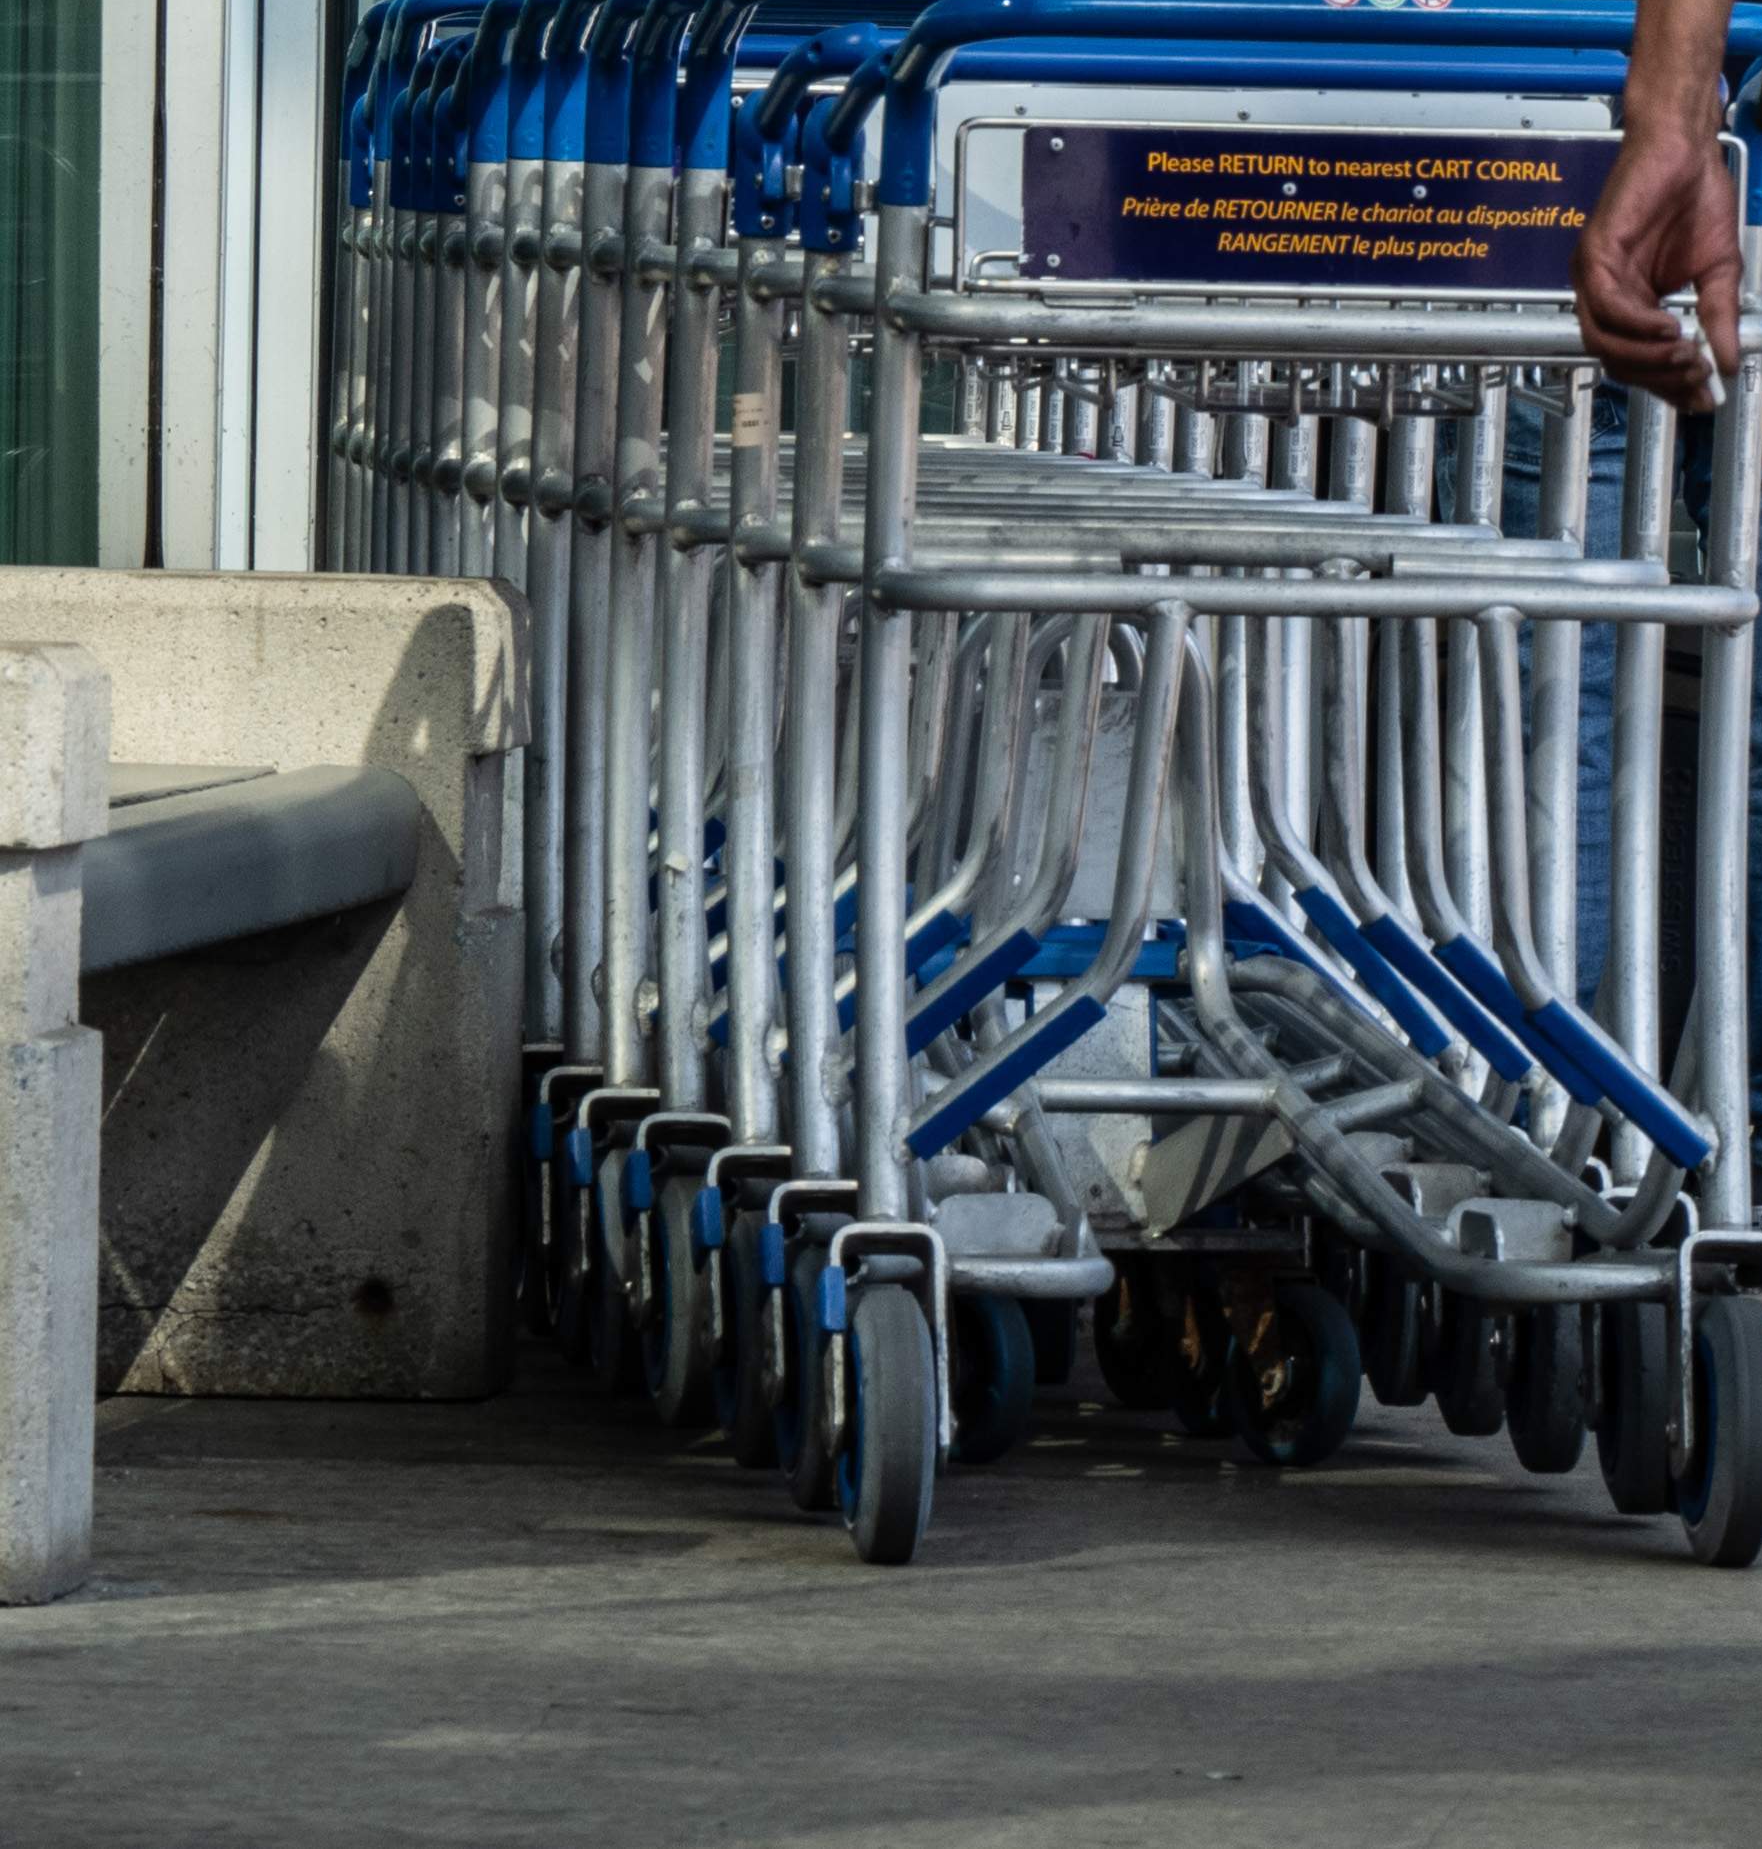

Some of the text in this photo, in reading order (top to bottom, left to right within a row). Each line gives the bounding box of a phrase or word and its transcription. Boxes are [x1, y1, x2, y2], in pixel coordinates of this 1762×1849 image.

[1147, 152, 1562, 182] Please RETURN to nearest CART CORRAL
[1122, 197, 1585, 230] Prière de RETOURNER le chariot au dispositif de
[1217, 232, 1489, 261] RANGEMENT le plus proche
